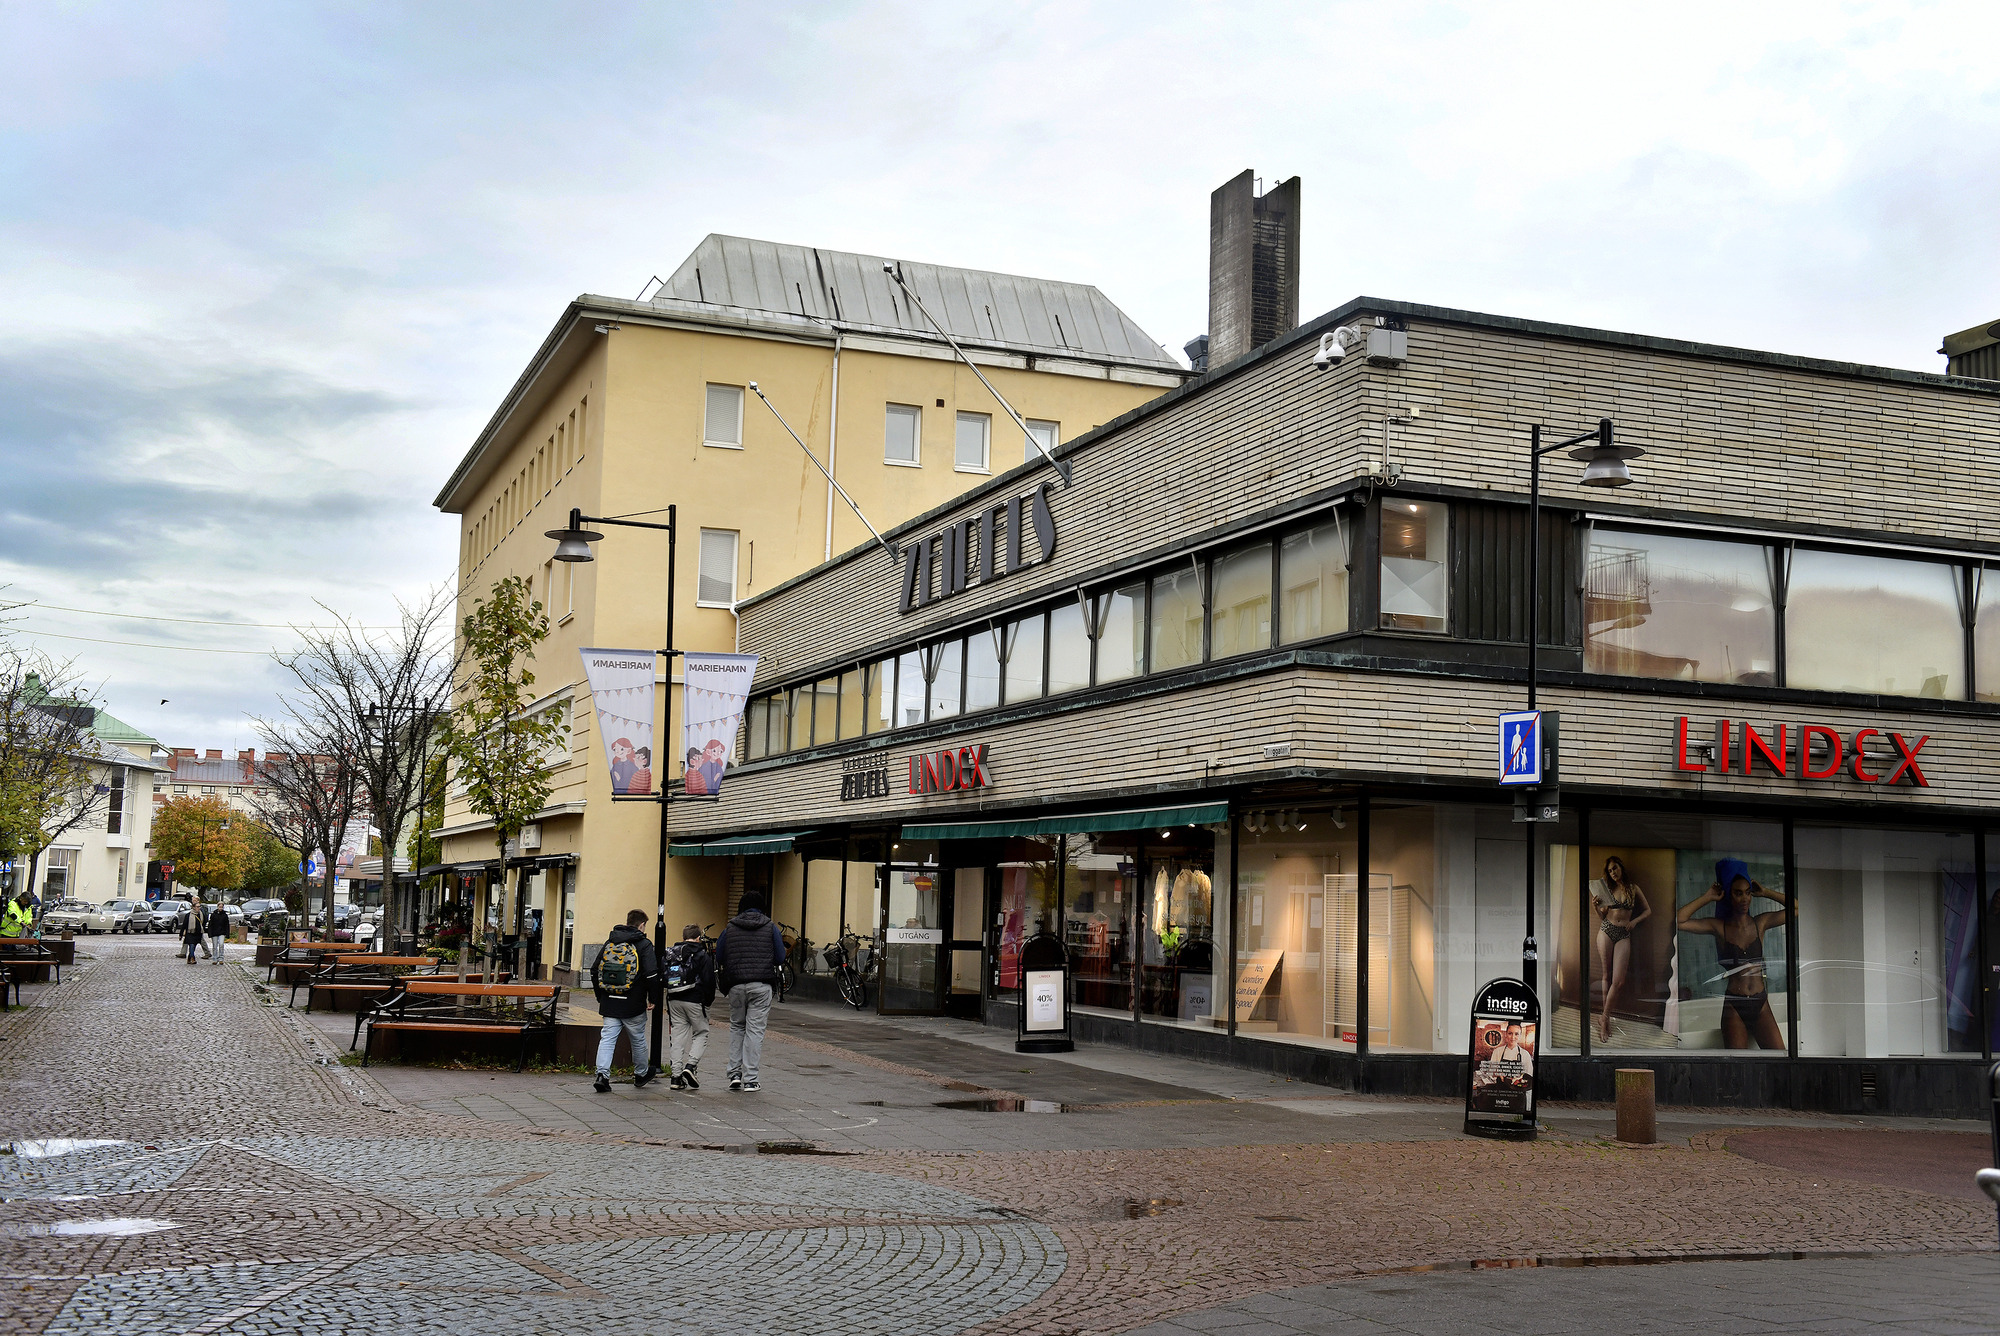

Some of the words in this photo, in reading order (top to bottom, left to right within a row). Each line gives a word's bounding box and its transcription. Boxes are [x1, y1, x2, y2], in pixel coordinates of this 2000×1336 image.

[688, 663, 747, 673] MARIEHAMN
[1673, 716, 1930, 787] LINDEX
[909, 744, 992, 794] LINDEX
[1004, 894, 1023, 910] SALE
[898, 931, 930, 939] UTGÅNG
[1487, 996, 1528, 1013] indigo
